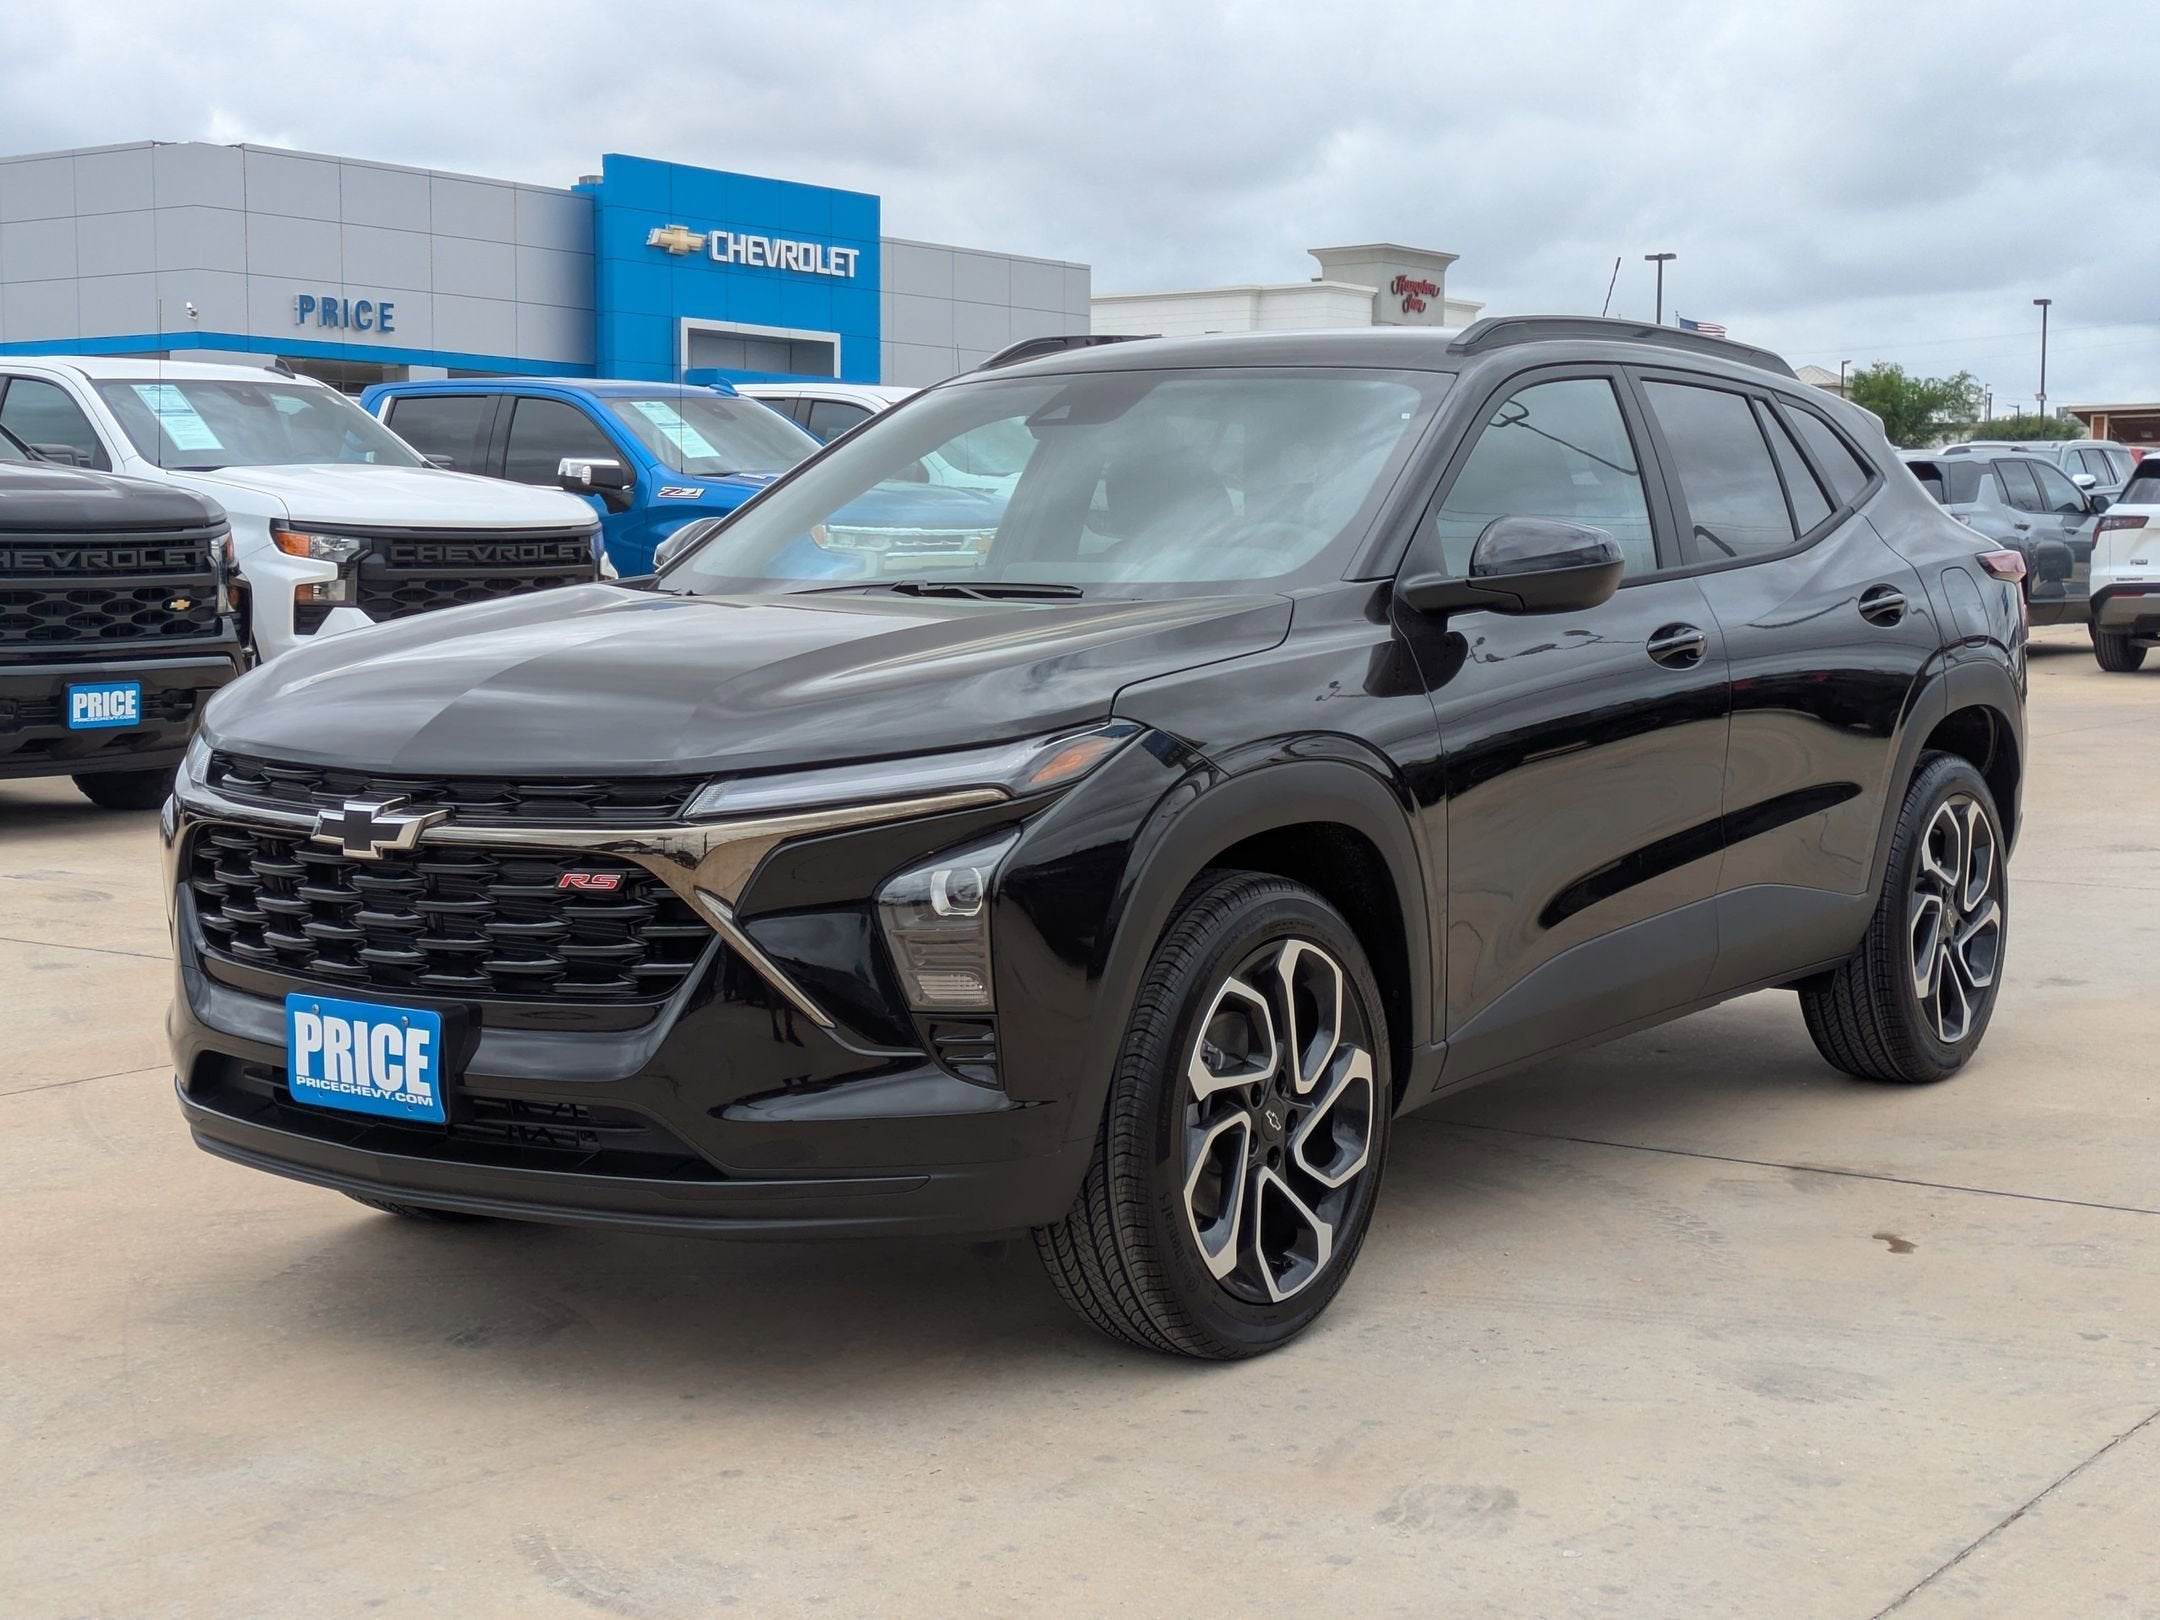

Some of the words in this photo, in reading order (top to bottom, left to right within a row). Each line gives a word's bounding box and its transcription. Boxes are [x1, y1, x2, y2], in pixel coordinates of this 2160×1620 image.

[709, 230, 859, 278] CHEVROLET
[296, 294, 395, 333] PRICE
[390, 542, 590, 562] CHEVROLET
[73, 690, 136, 719] PRICE
[558, 873, 621, 889] RS
[294, 1011, 432, 1097] PRICE
[296, 1076, 433, 1106] PRICECHEVY.COM
